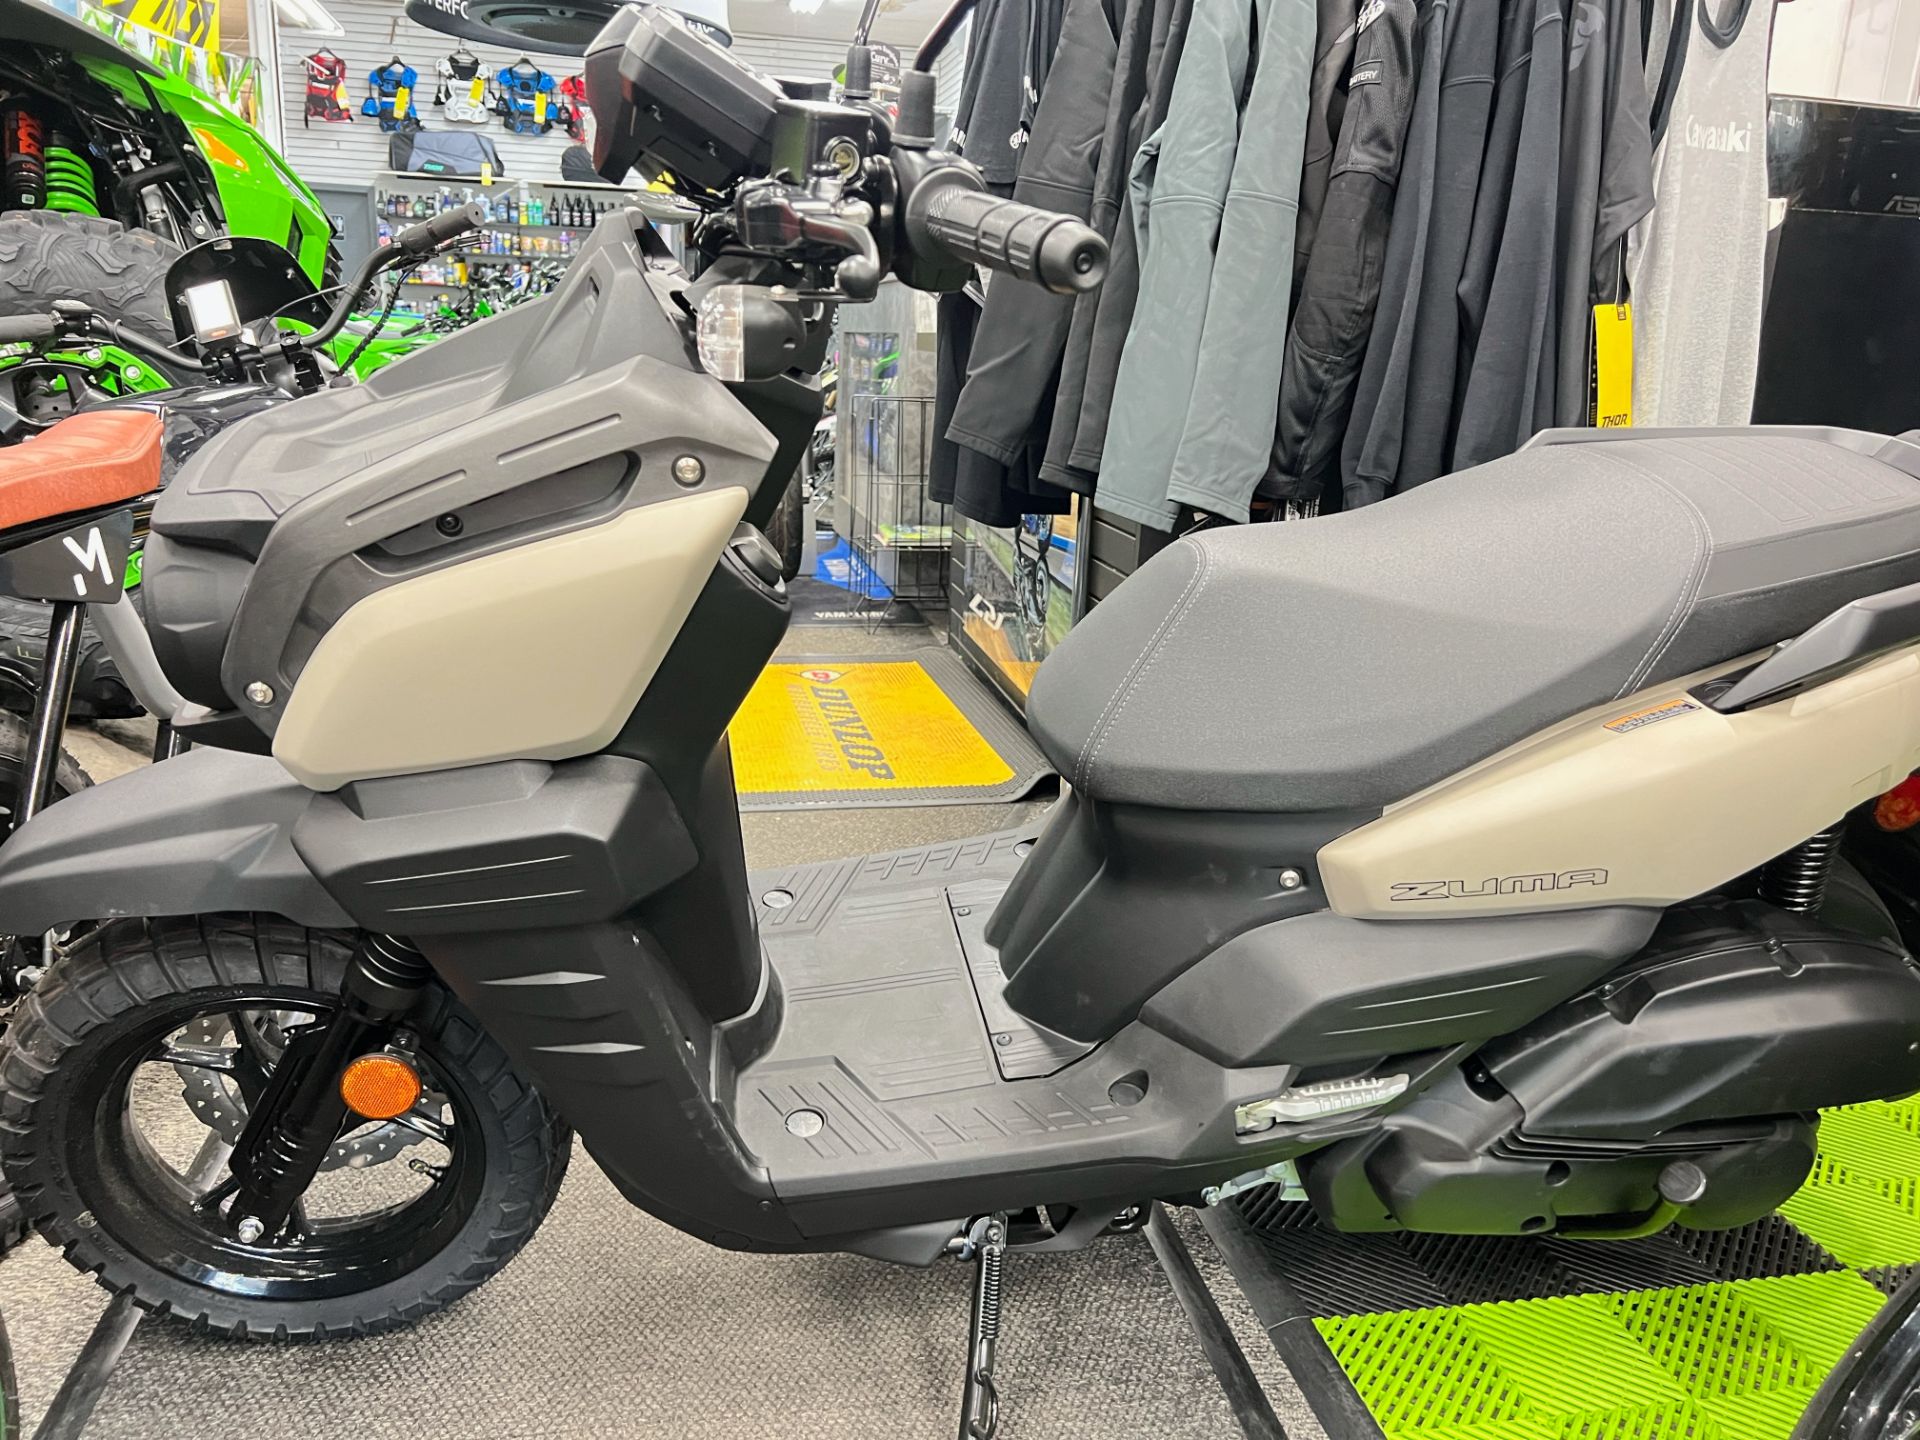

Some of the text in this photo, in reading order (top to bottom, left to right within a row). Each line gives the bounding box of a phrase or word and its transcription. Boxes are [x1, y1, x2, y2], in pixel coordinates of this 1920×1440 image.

[1883, 194, 1920, 214] AS
[1602, 413, 1628, 428] THOR
[810, 685, 896, 780] DUNLOP
[1391, 867, 1608, 901] ZUMA
